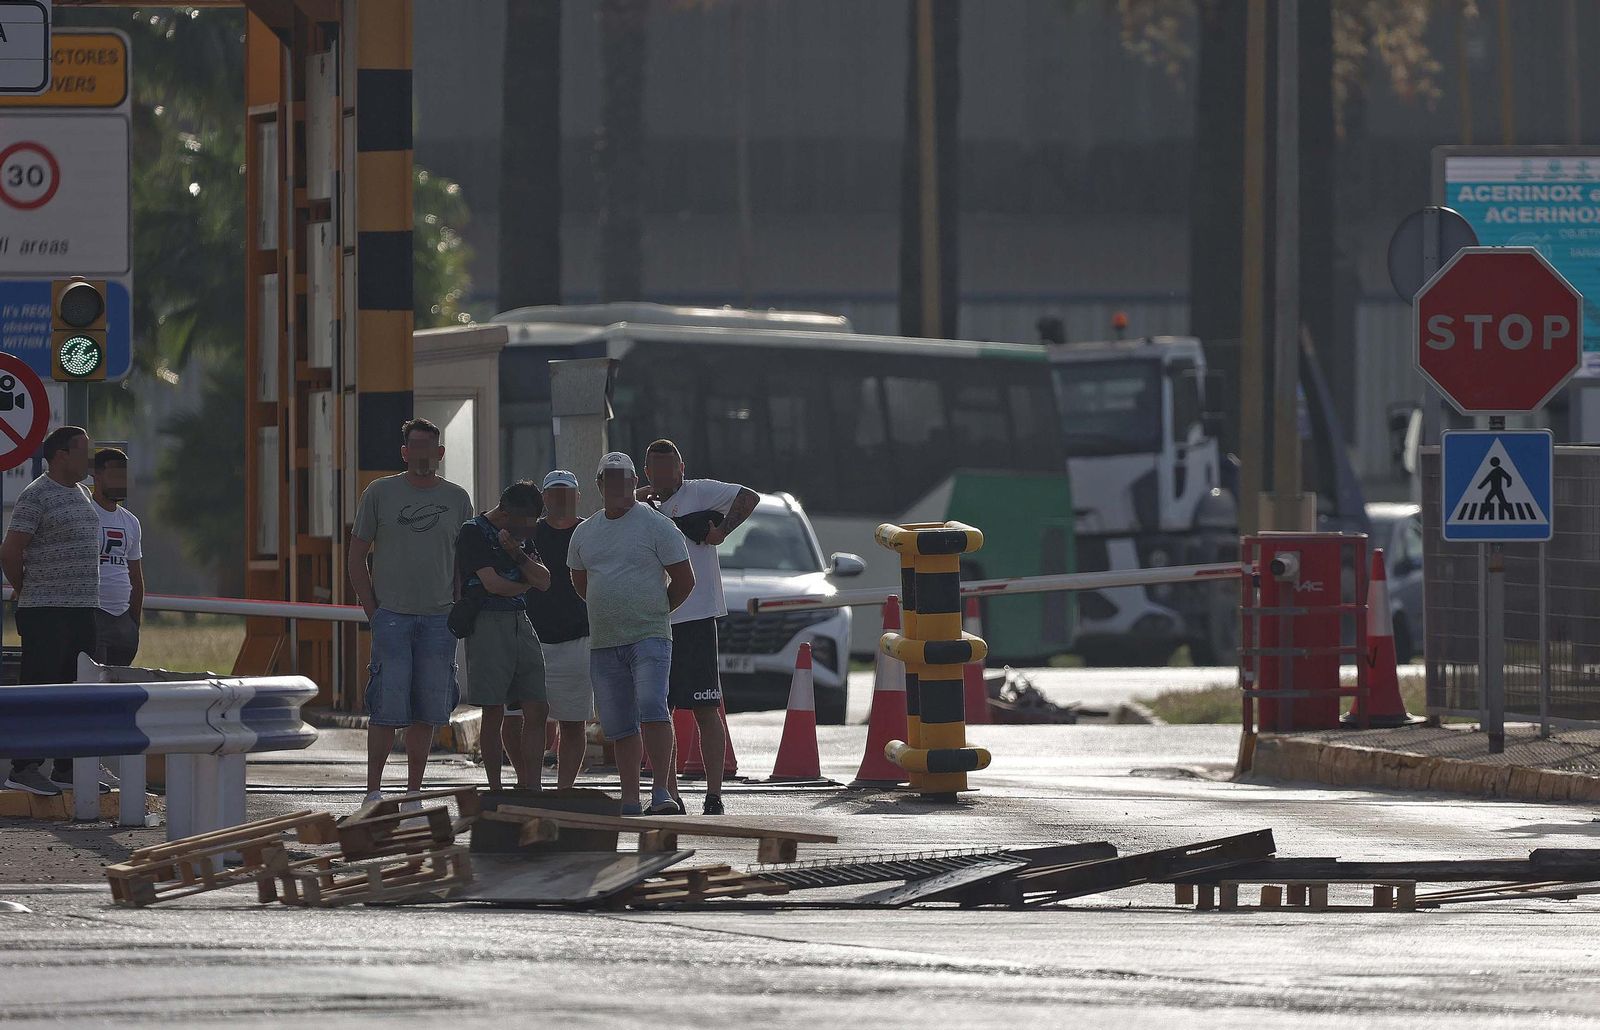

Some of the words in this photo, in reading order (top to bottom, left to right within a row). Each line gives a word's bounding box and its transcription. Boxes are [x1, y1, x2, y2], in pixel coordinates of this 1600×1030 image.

[51, 48, 119, 65] CTORES
[7, 164, 44, 187] 30
[1457, 185, 1584, 202] ACERINOX
[19, 239, 70, 255] areas
[1425, 313, 1570, 350] STOP
[100, 556, 125, 565] FILA
